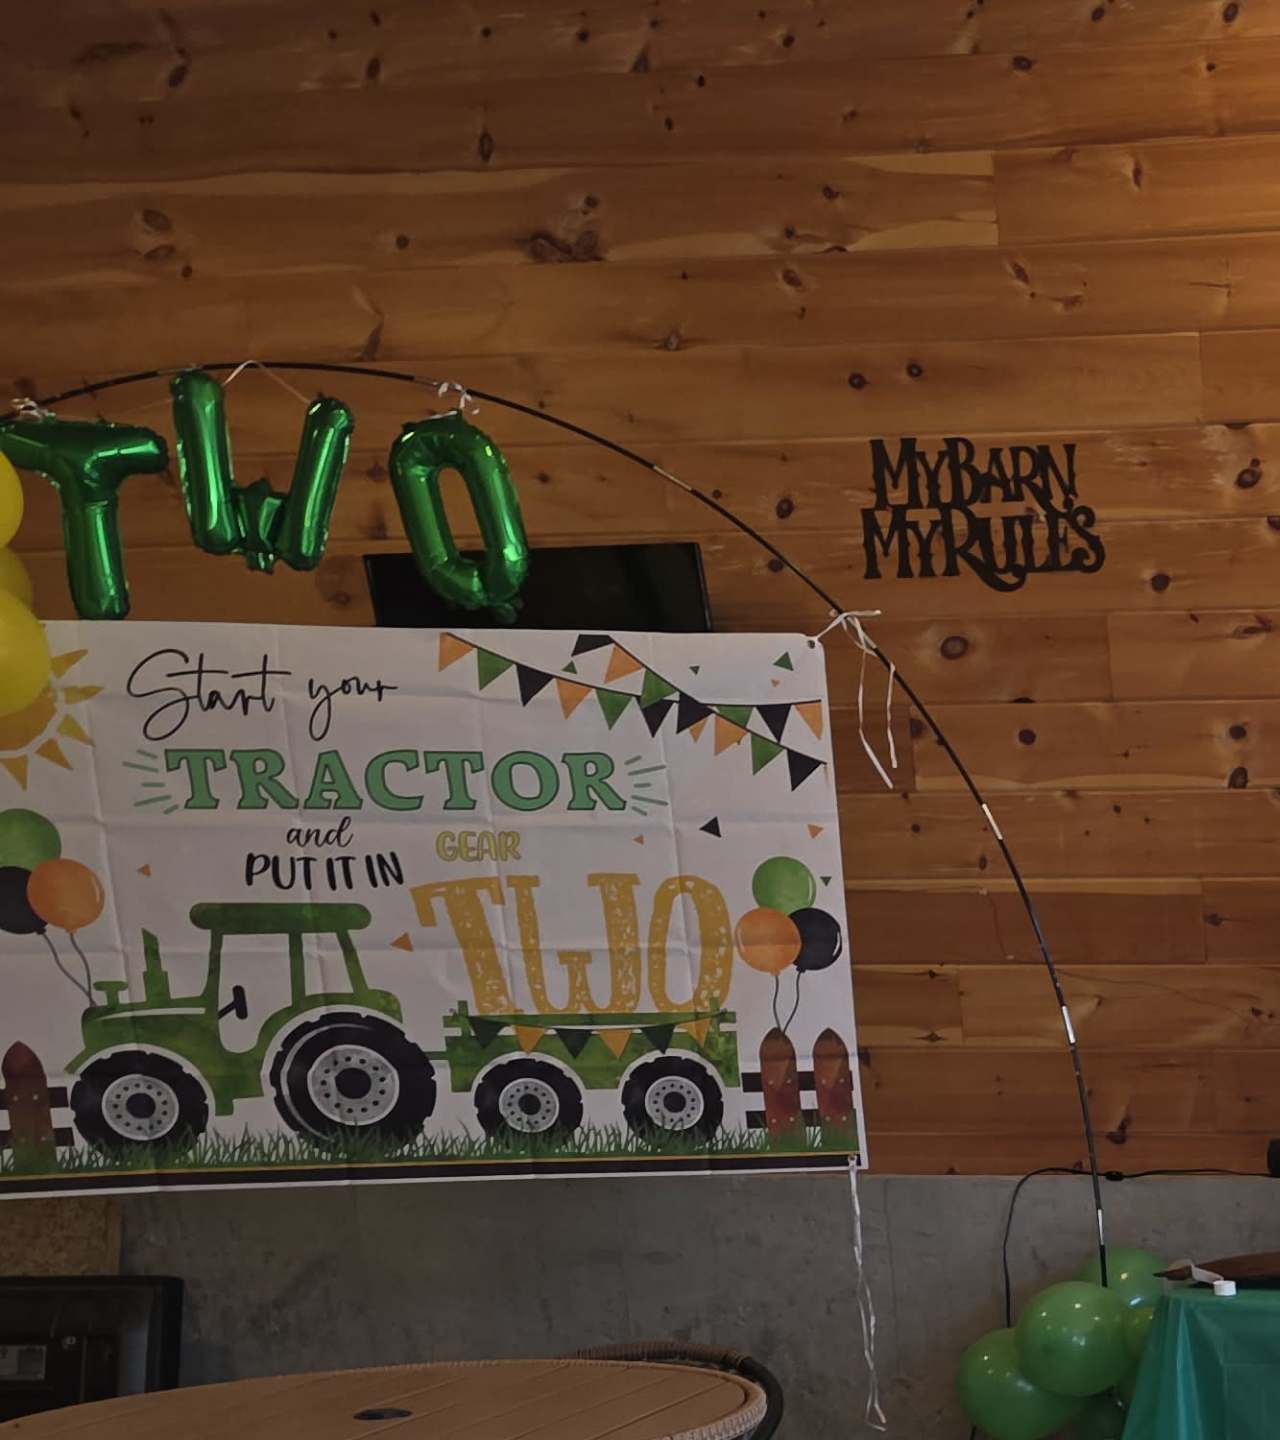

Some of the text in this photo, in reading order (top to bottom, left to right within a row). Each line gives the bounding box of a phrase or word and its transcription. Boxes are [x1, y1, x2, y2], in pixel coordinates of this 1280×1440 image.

[0, 367, 529, 622] TWO
[126, 646, 399, 742] Start your
[163, 747, 628, 813] TRACTOR
[284, 815, 354, 848] and
[436, 830, 521, 862] GEAR
[245, 850, 405, 891] PUT IT IN
[410, 872, 736, 1018] TWO
